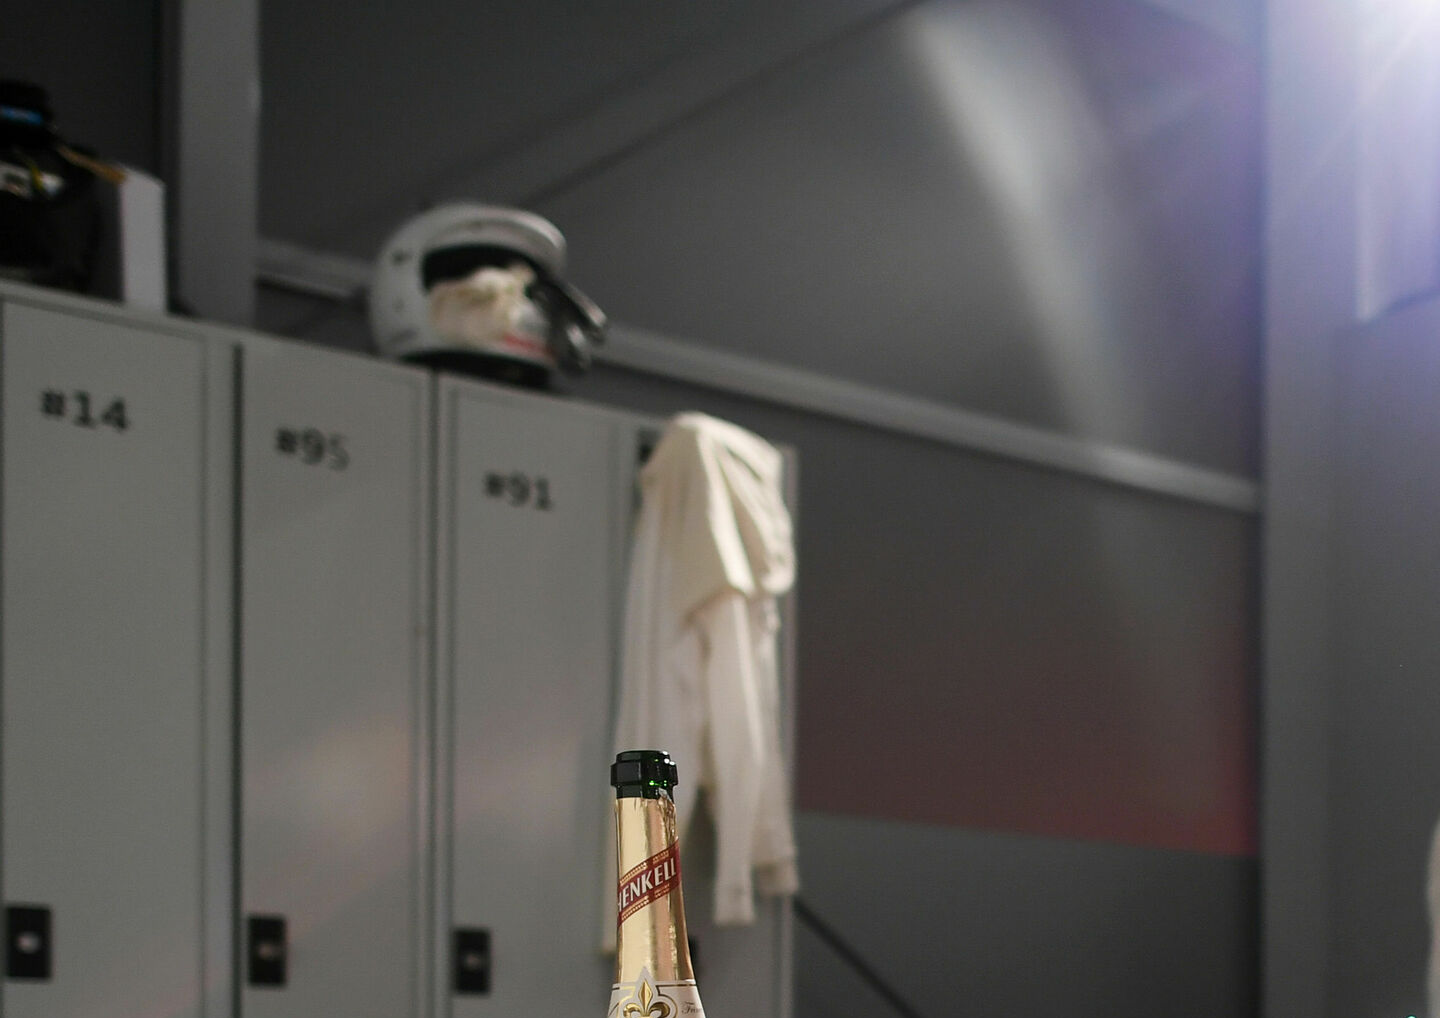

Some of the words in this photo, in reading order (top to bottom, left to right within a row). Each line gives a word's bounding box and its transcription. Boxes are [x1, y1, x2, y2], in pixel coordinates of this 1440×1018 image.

[40, 388, 131, 434] #14
[274, 426, 350, 471] #95
[483, 471, 555, 512] #91
